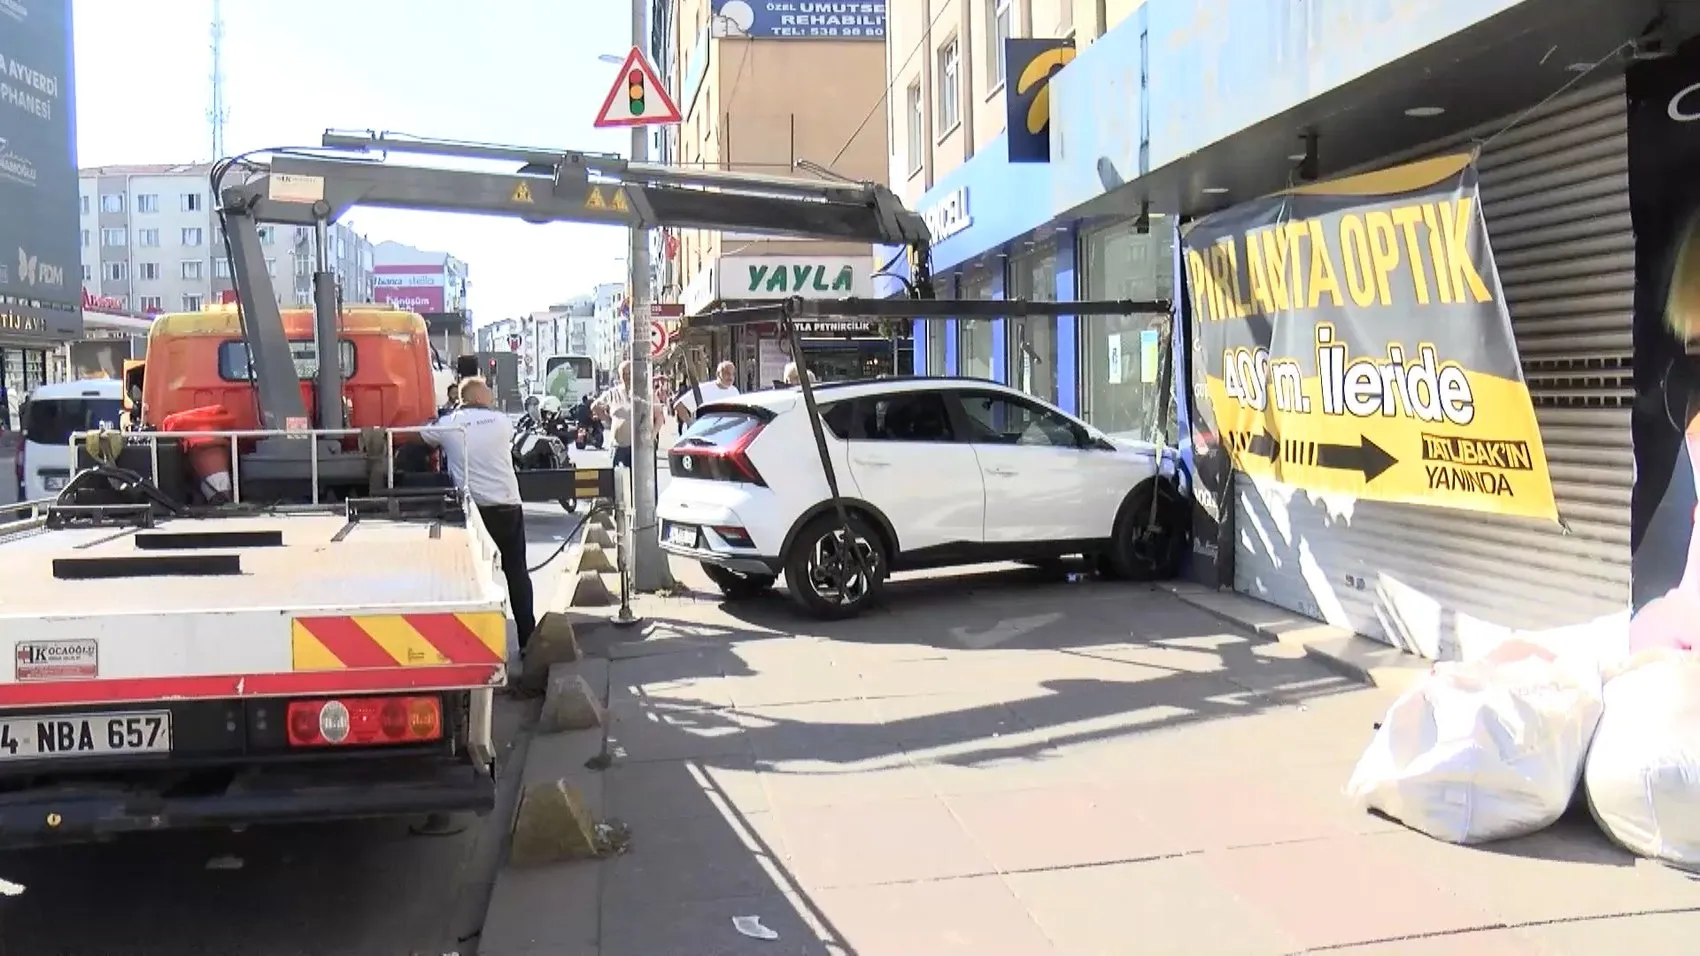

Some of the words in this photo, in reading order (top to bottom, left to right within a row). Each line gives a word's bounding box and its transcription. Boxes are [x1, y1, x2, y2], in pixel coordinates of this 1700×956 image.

[9, 58, 58, 98] AYVERDİ
[1188, 218, 1344, 323] PIRLANTA
[1271, 361, 1312, 414] m.
[1425, 464, 1514, 497] YANINDA
[37, 720, 94, 752] NBA
[107, 717, 161, 749] 657
